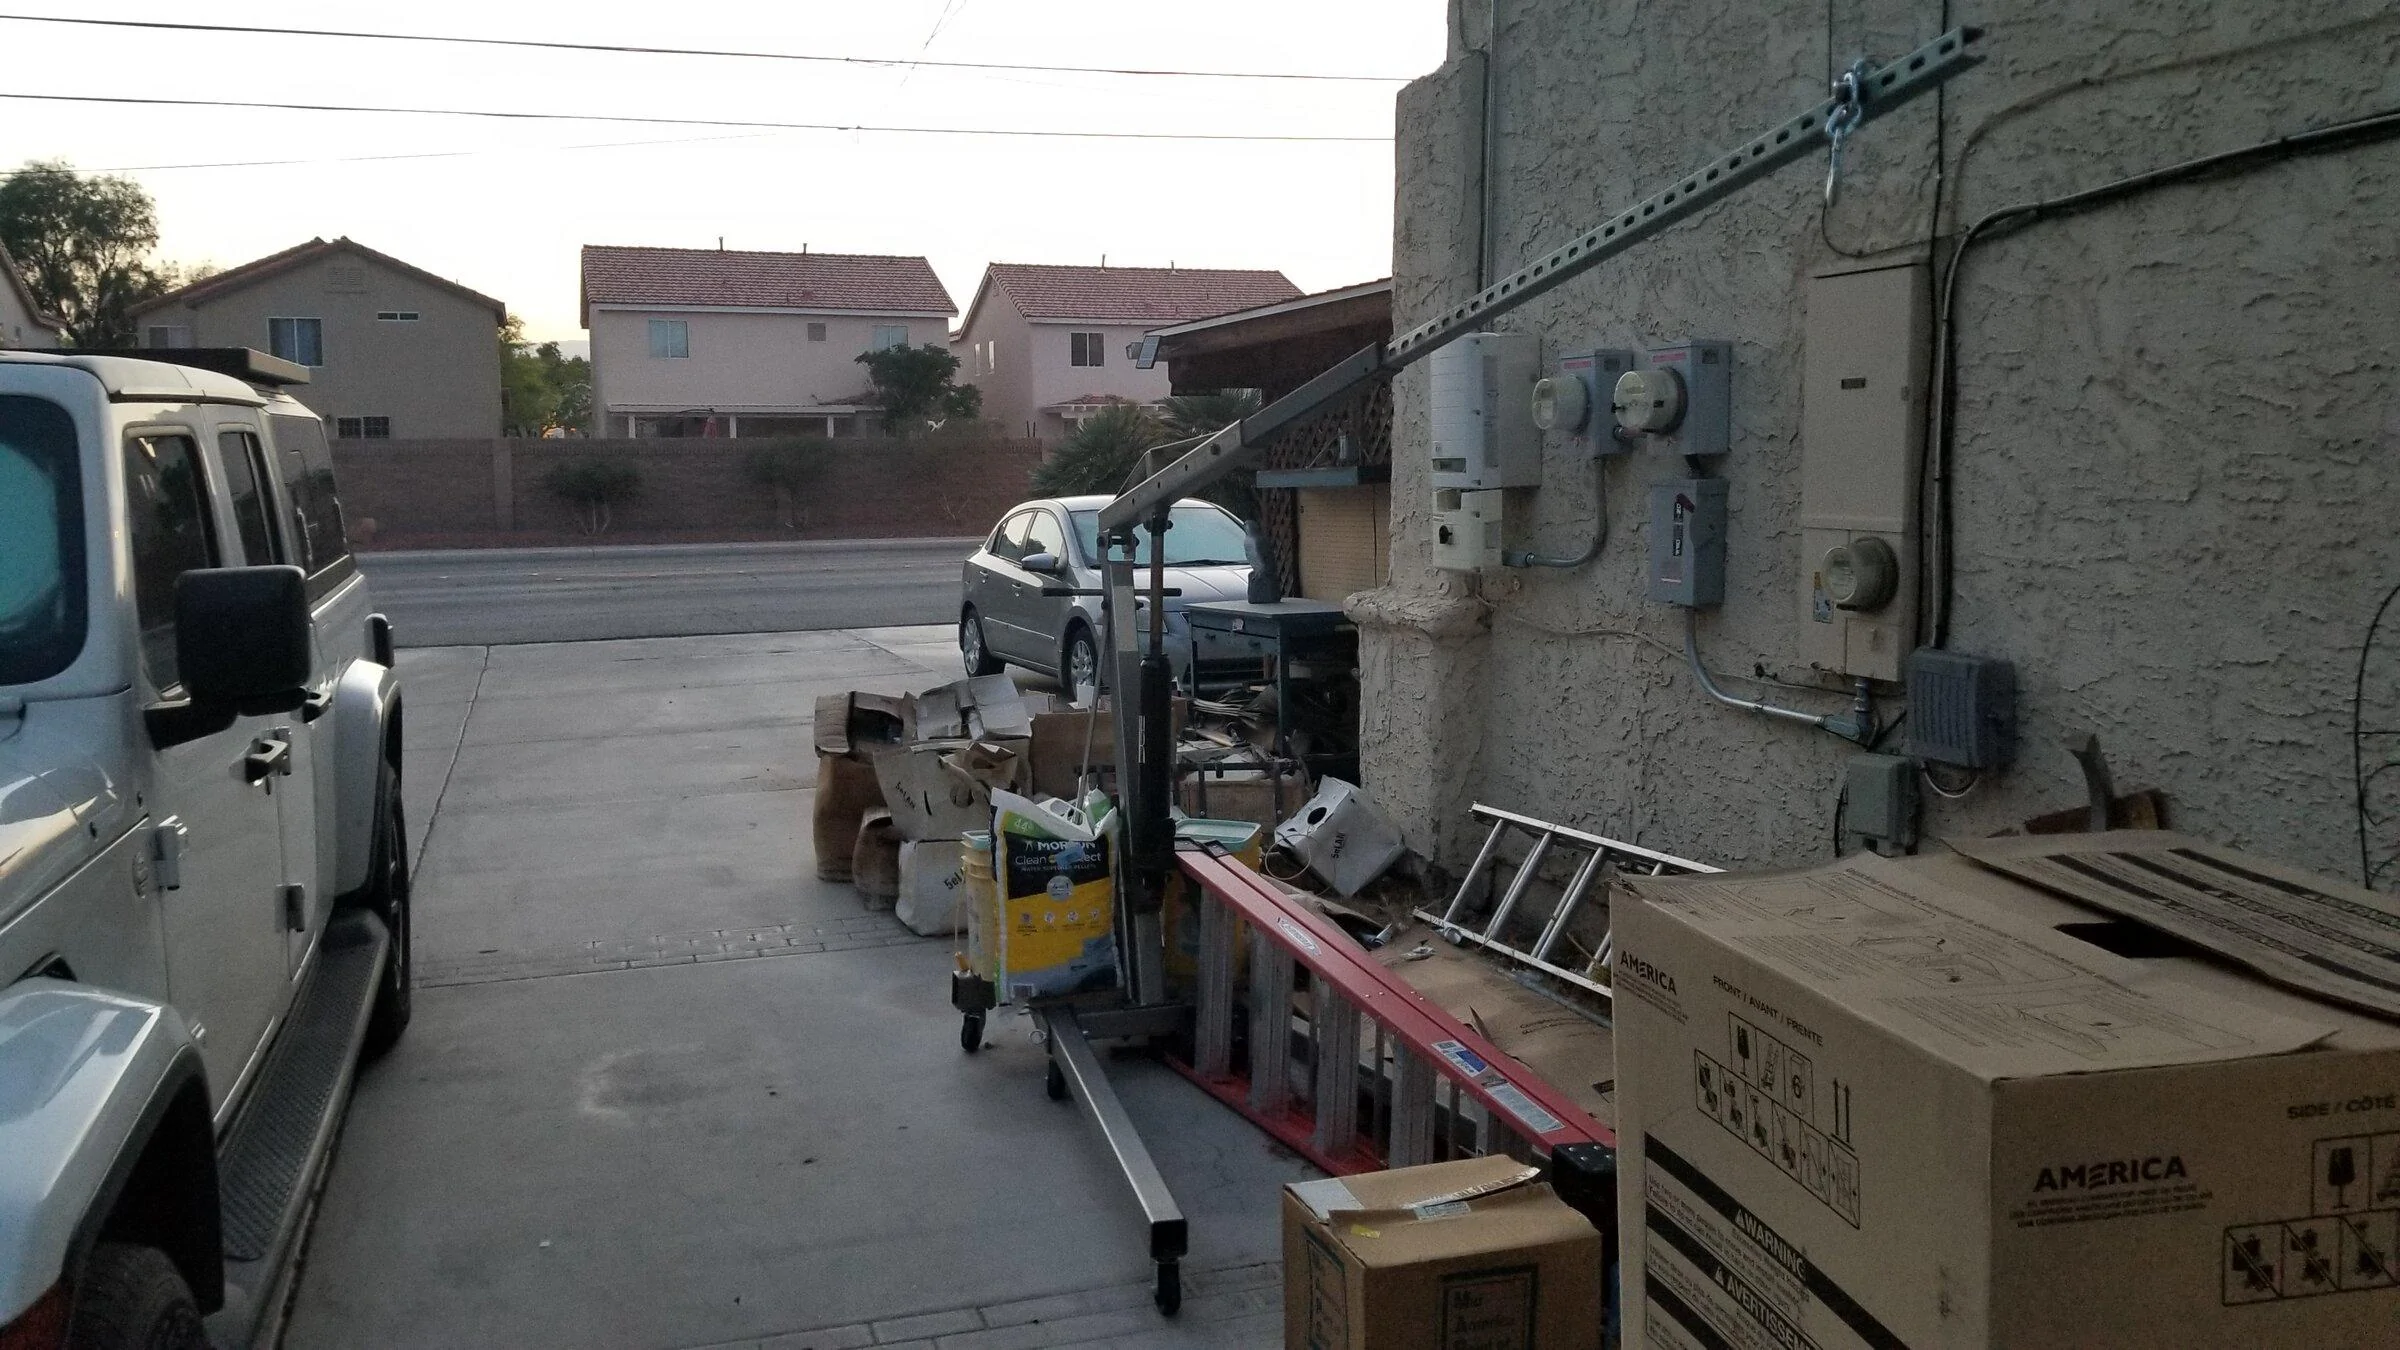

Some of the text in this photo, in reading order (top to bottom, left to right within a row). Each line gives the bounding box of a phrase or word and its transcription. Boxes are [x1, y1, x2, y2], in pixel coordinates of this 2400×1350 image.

[1015, 855, 1047, 865] Clean
[1037, 840, 1096, 851] MORN
[1619, 950, 1677, 995] AMERICA
[1713, 975, 1741, 999] FRONT
[1749, 996, 1778, 1019] AVANT
[1786, 1017, 1824, 1047] FRENTE
[2287, 1102, 2329, 1119] SIDE
[2032, 1155, 2187, 1193] AMERICA
[1744, 1212, 1808, 1283] WARNING
